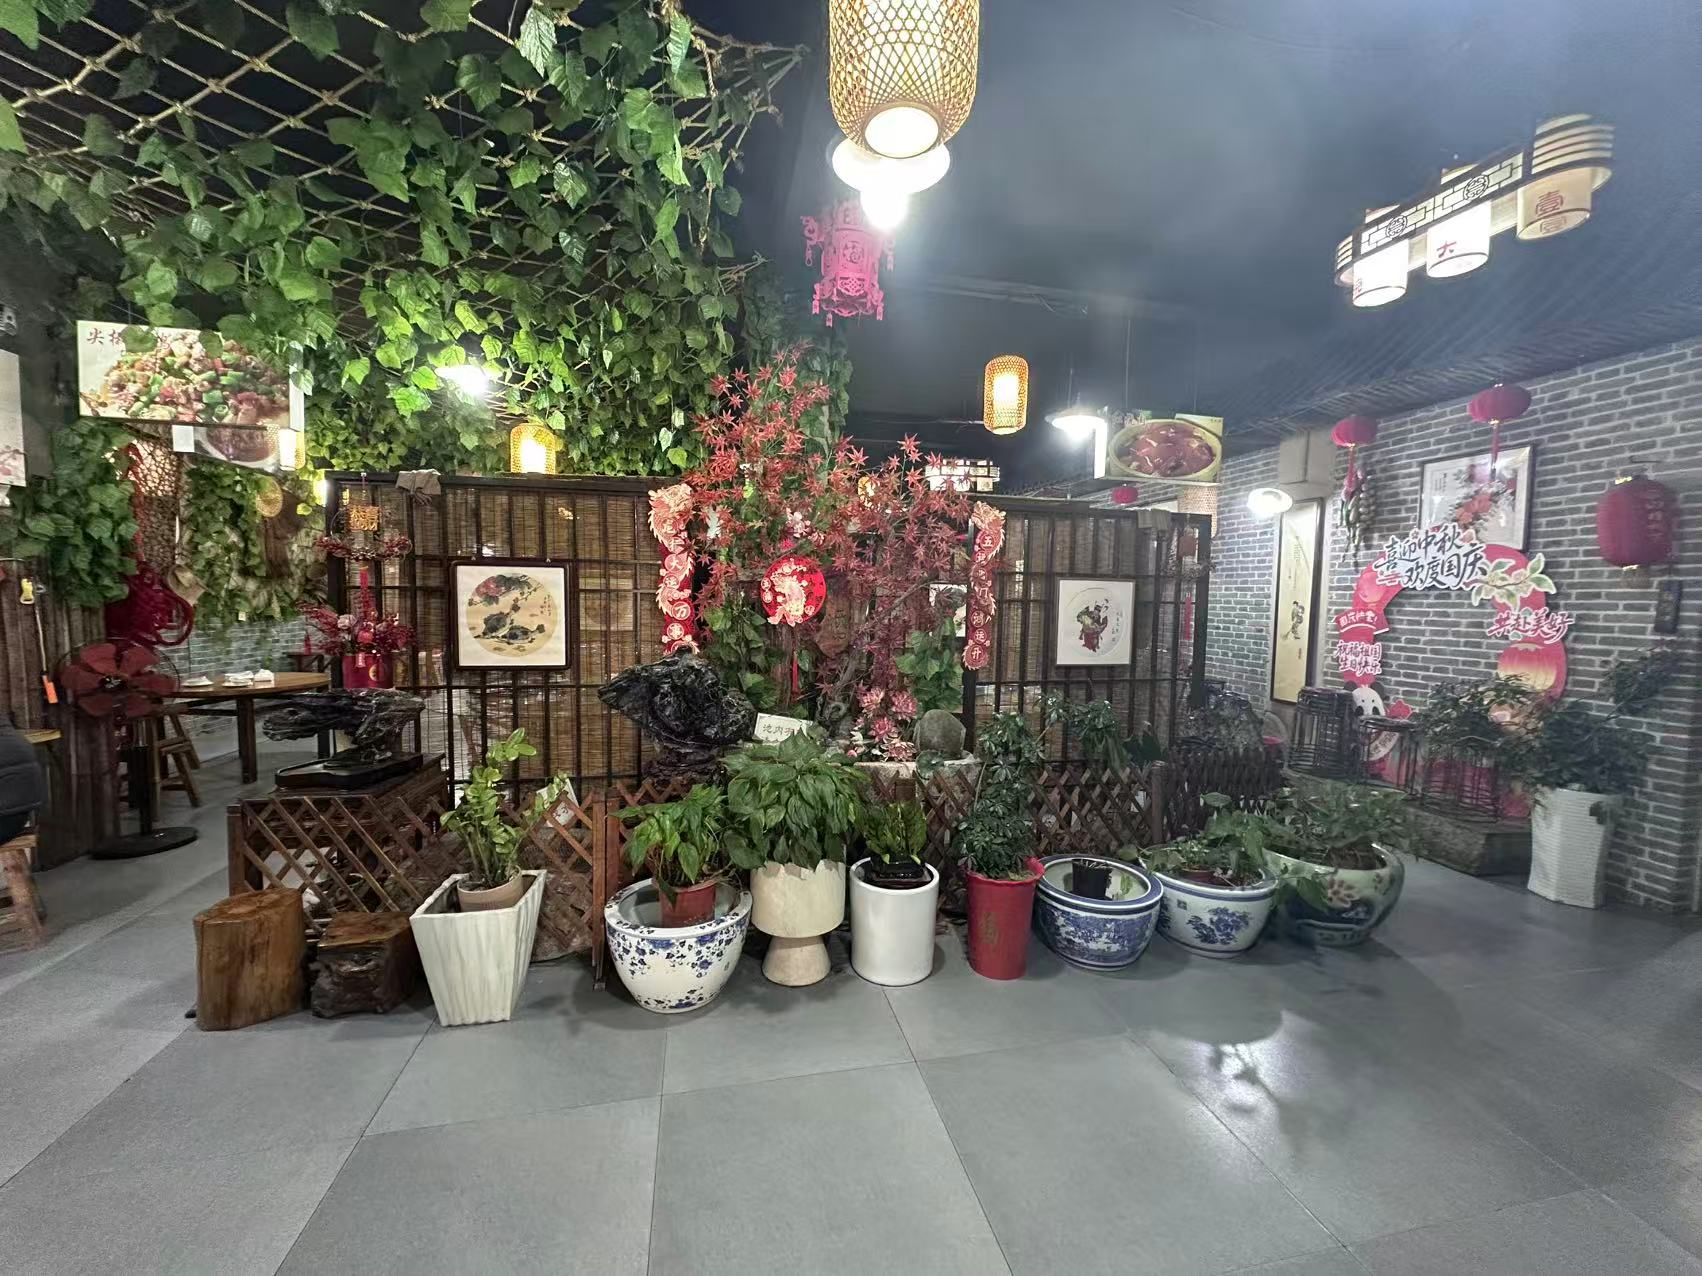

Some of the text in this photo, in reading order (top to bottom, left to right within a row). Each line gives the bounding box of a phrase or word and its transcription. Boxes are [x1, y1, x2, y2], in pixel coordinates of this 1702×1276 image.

[1374, 524, 1462, 572] 喜迎中秋
[1403, 542, 1488, 587] 欢度国庆
[1487, 607, 1575, 644] 共赴美好
